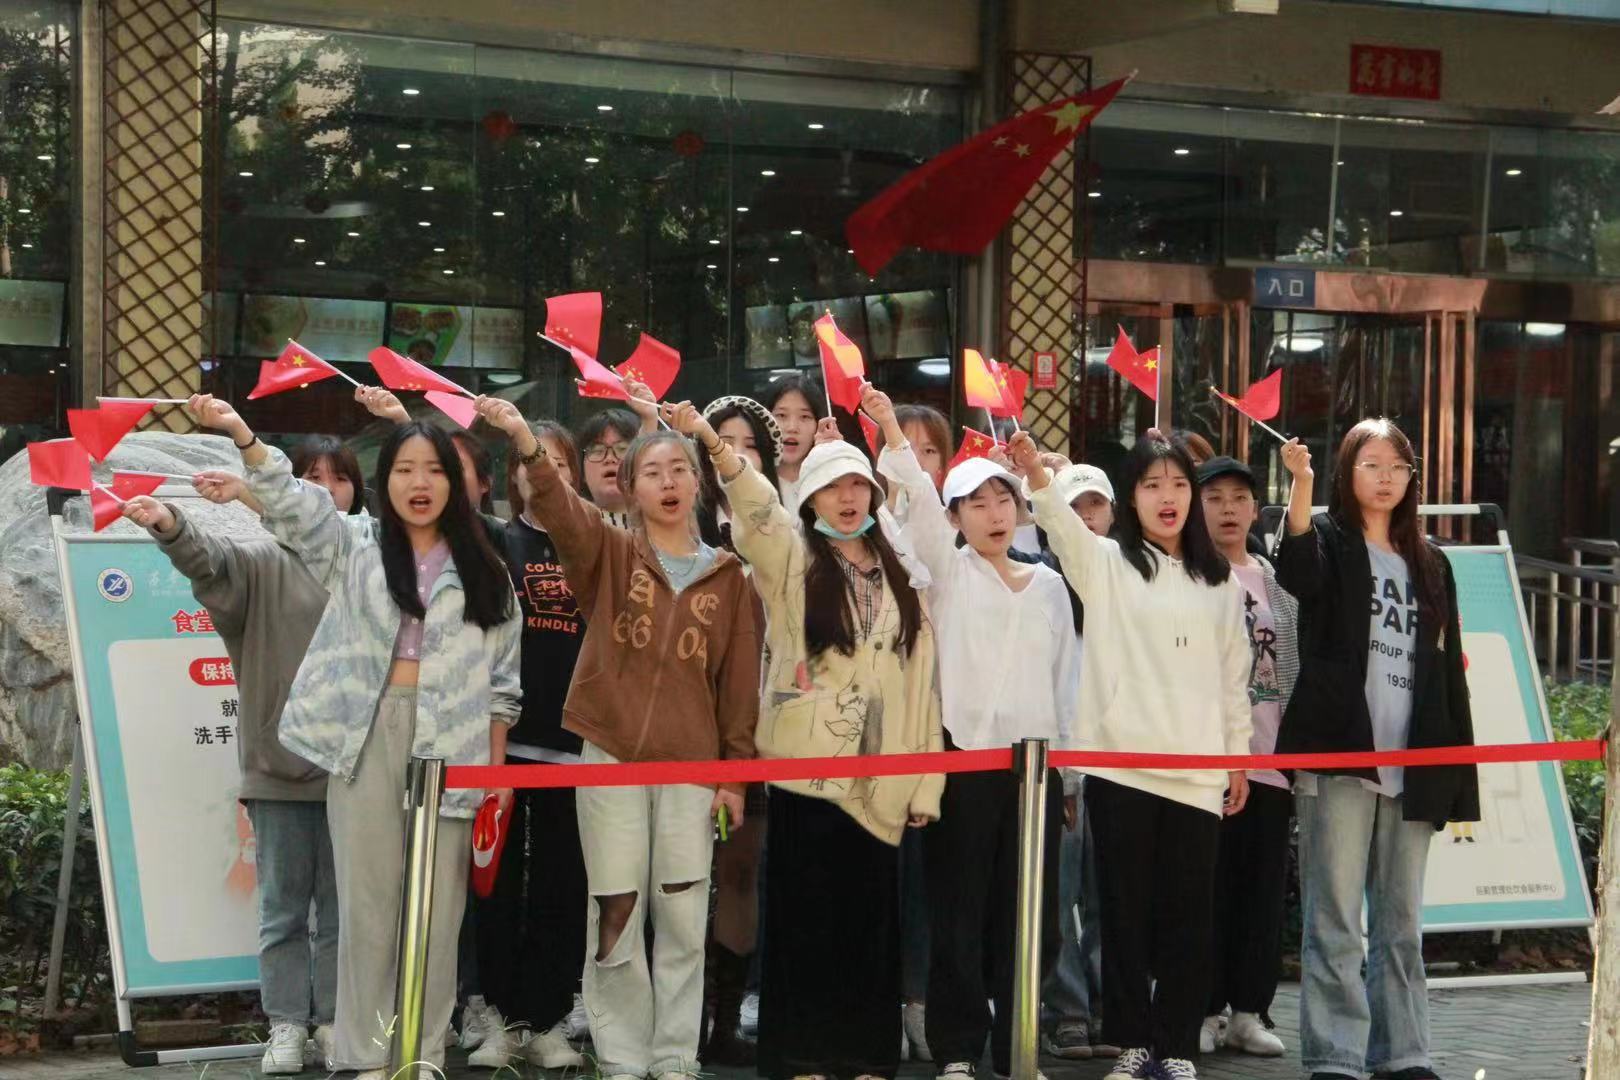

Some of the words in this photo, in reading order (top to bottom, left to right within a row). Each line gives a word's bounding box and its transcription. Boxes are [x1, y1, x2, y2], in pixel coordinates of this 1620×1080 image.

[1269, 278, 1304, 297] 入口
[525, 562, 564, 573] COUR
[527, 616, 578, 634] KINDLE
[1370, 640, 1403, 659] ROUP
[201, 662, 236, 681] 保持
[221, 698, 239, 717] 就
[194, 725, 238, 744] 洗手
